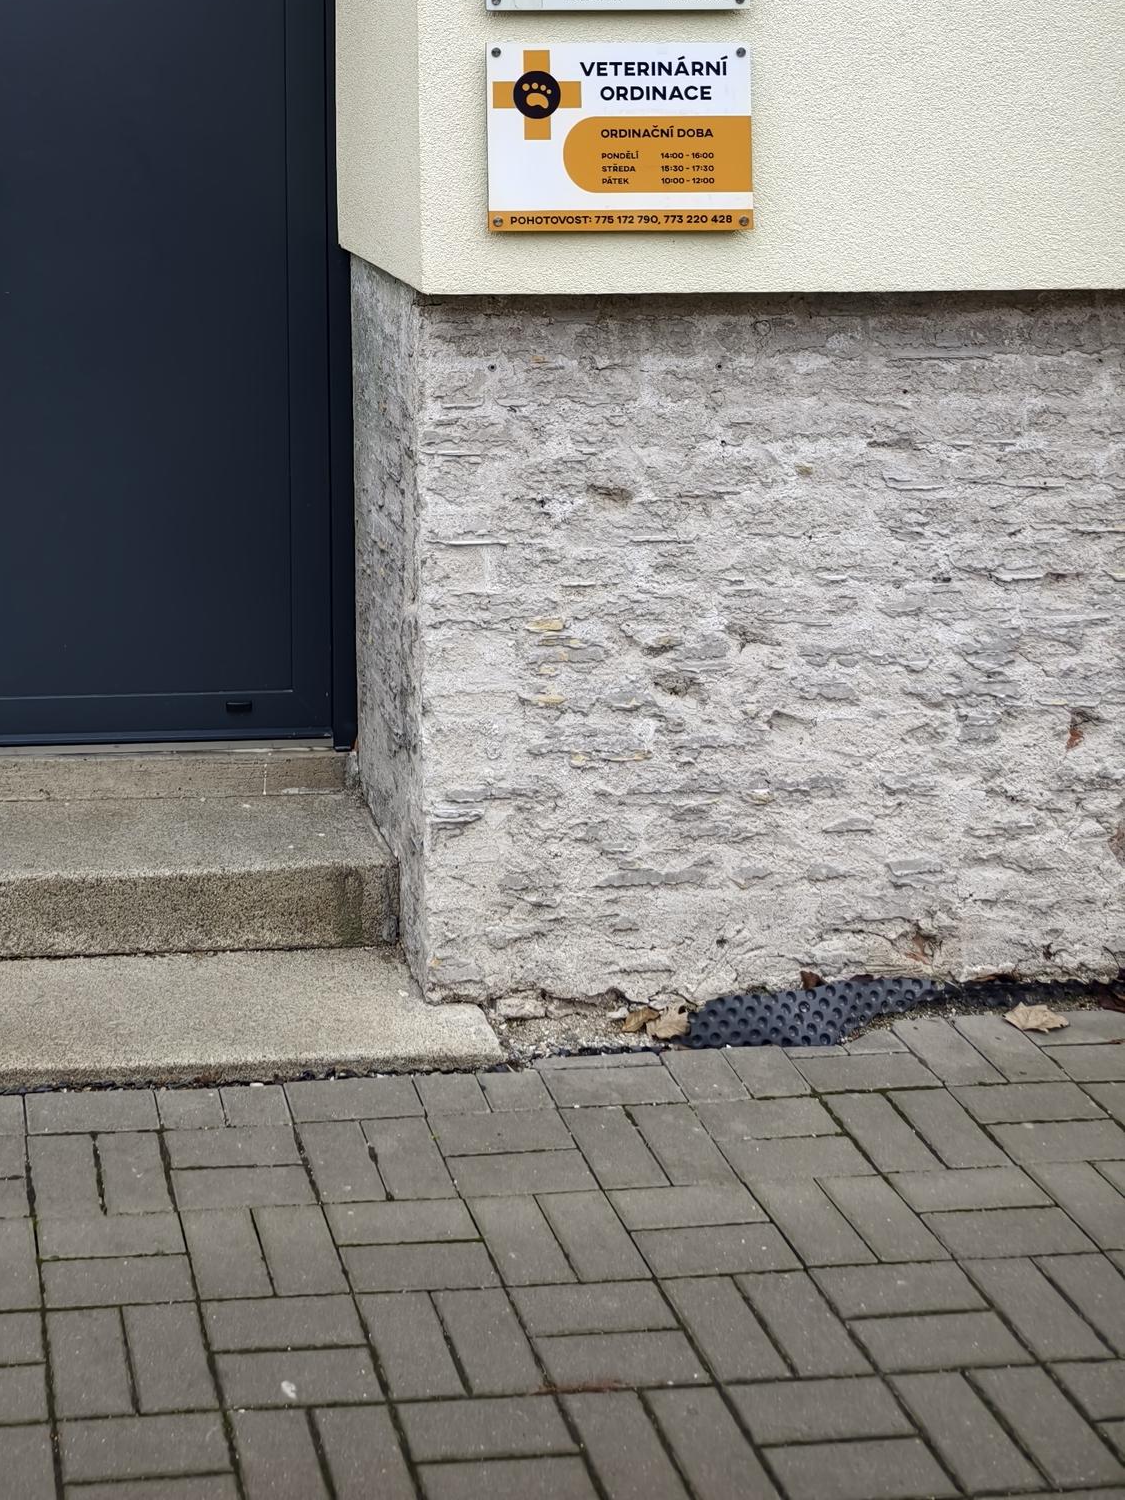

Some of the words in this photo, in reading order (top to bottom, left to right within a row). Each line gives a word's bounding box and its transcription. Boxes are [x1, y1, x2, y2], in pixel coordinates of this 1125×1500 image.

[580, 56, 728, 77] VETERINÁRNÍ
[600, 86, 712, 101] ORDINACE
[601, 125, 674, 138] ORDINAČNÍ
[677, 128, 714, 138] DOBA
[601, 151, 639, 160] PONDĚLÍ
[601, 164, 636, 172] STŘEDA
[602, 176, 629, 184] PÁTEK
[510, 216, 592, 225] POHOTOVOST:
[594, 216, 614, 224] 775
[617, 216, 634, 224] 172
[637, 215, 661, 225] 790,
[663, 215, 683, 224] 773
[686, 215, 708, 224] 220
[711, 215, 733, 224] 428
